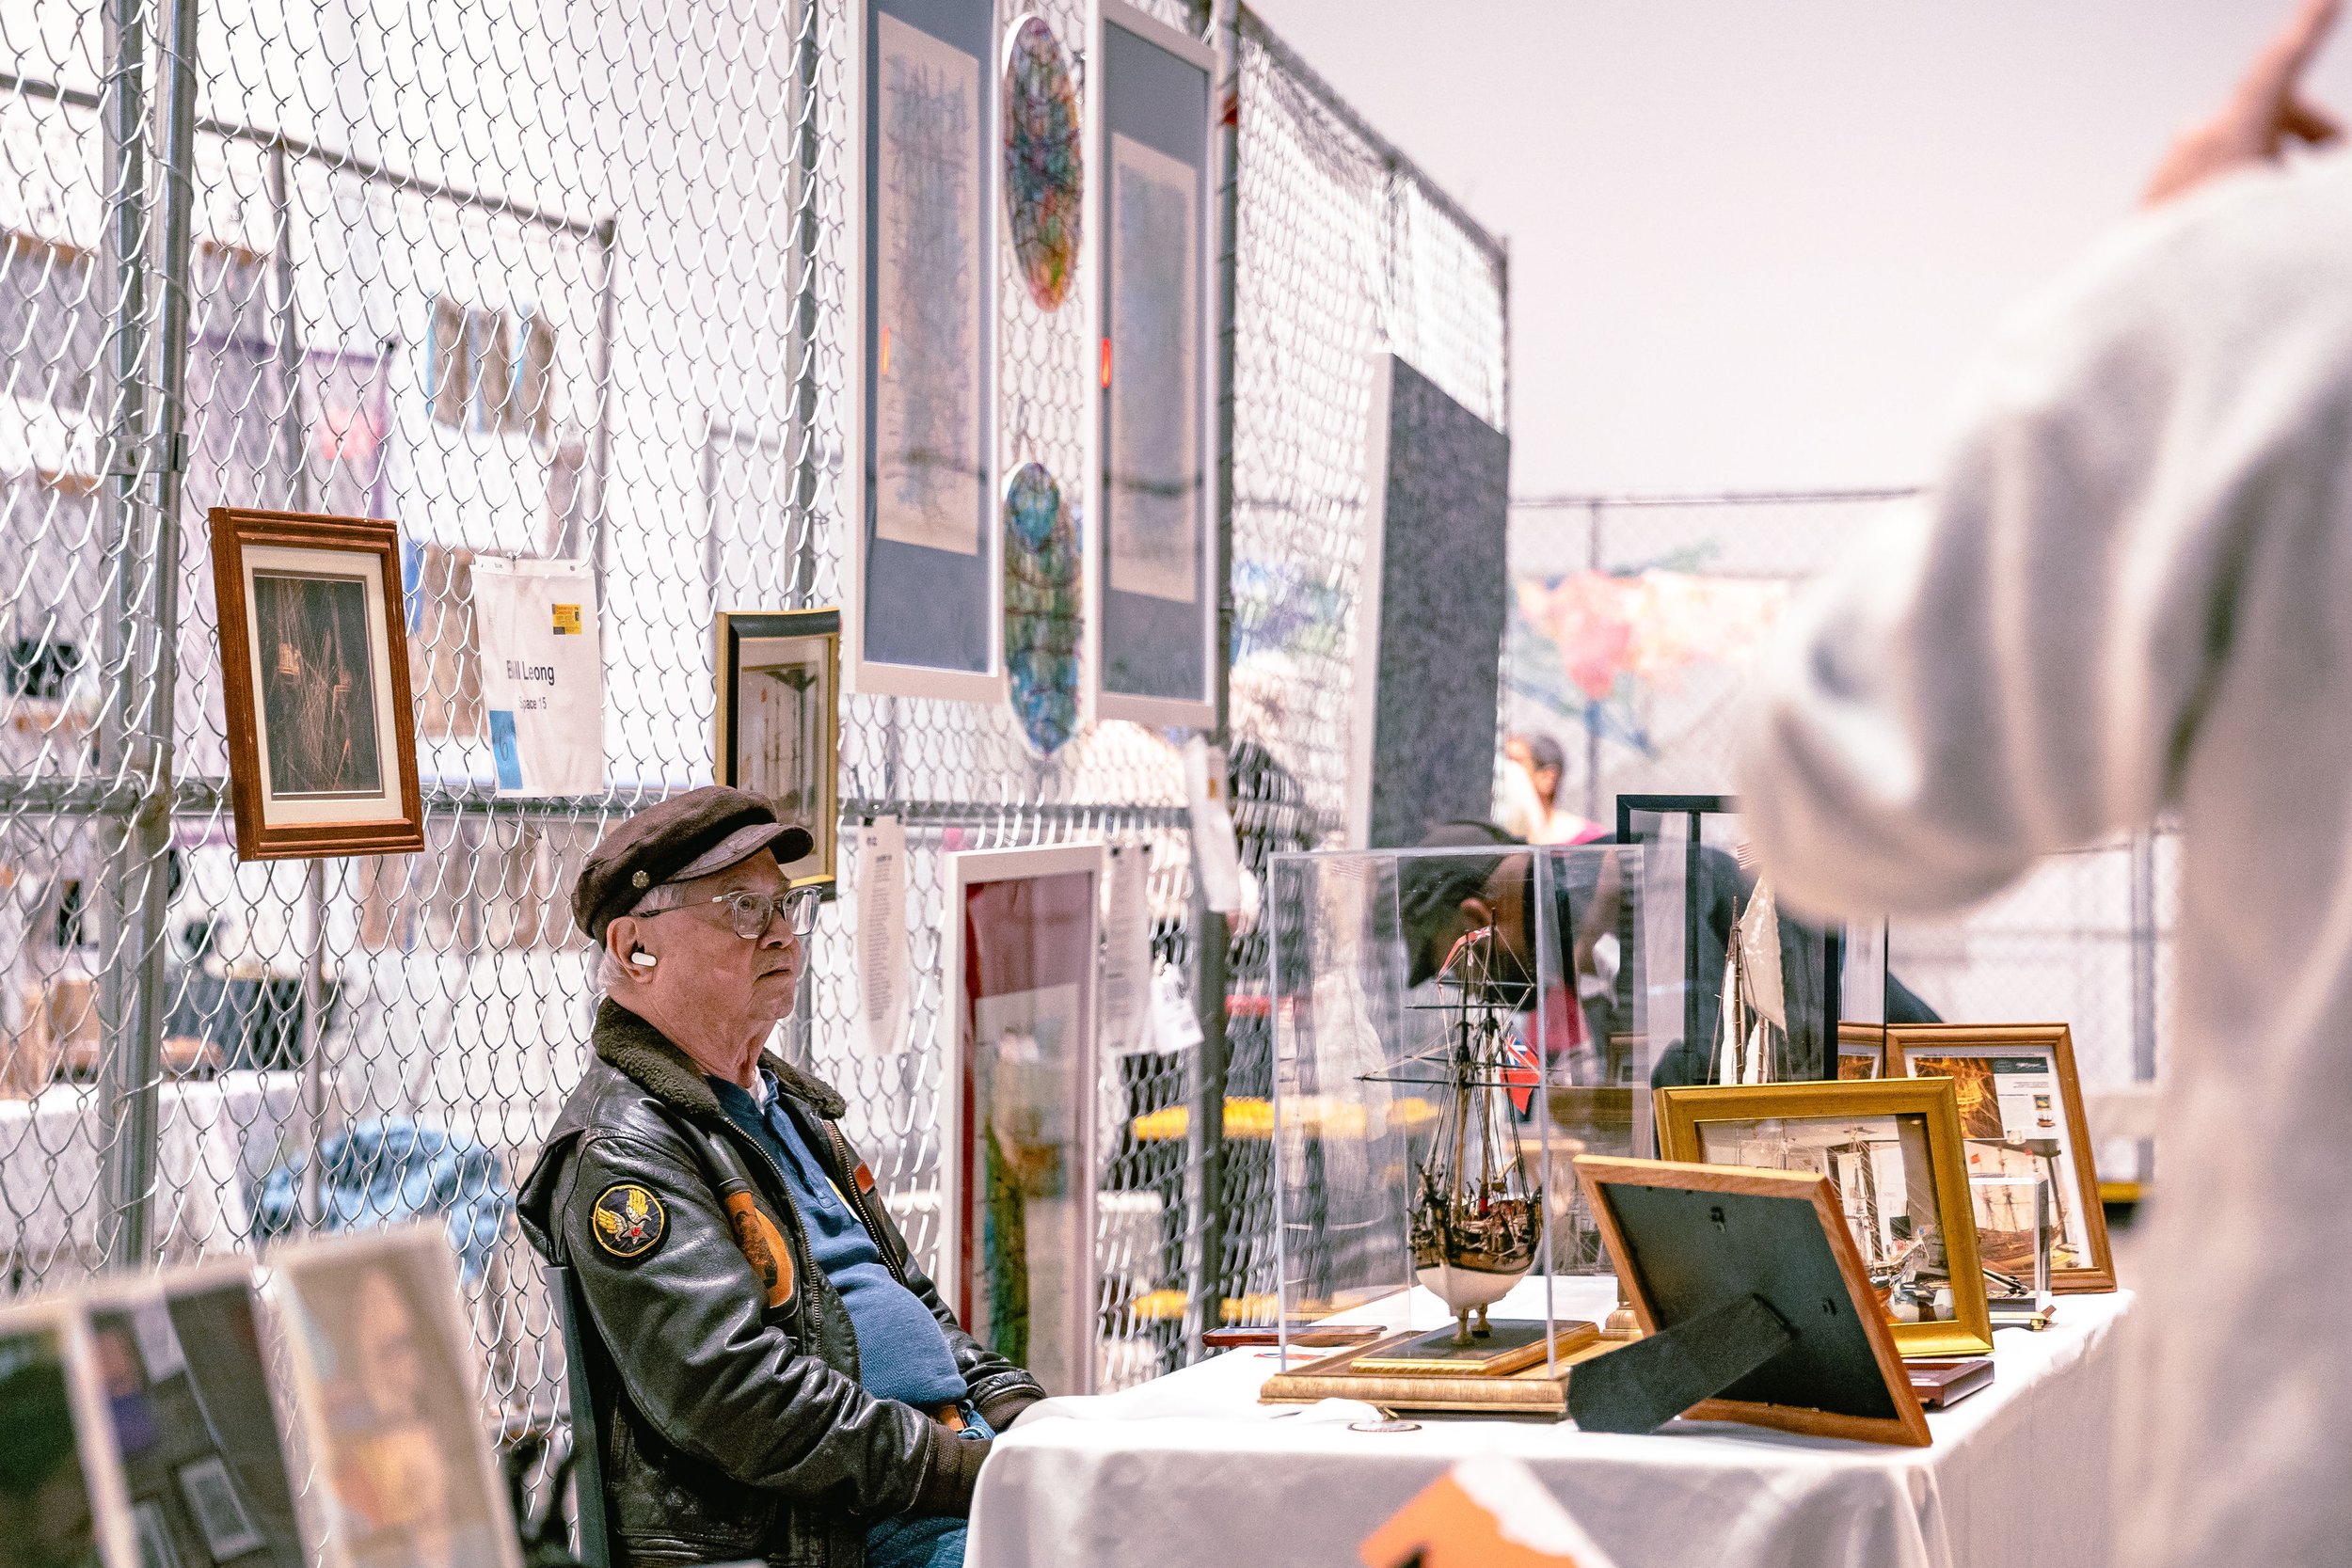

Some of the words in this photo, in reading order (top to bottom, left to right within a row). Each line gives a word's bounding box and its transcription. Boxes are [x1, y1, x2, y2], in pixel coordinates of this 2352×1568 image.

[522, 661, 555, 686] Leong
[519, 696, 537, 713] Space
[539, 697, 547, 709] 15
